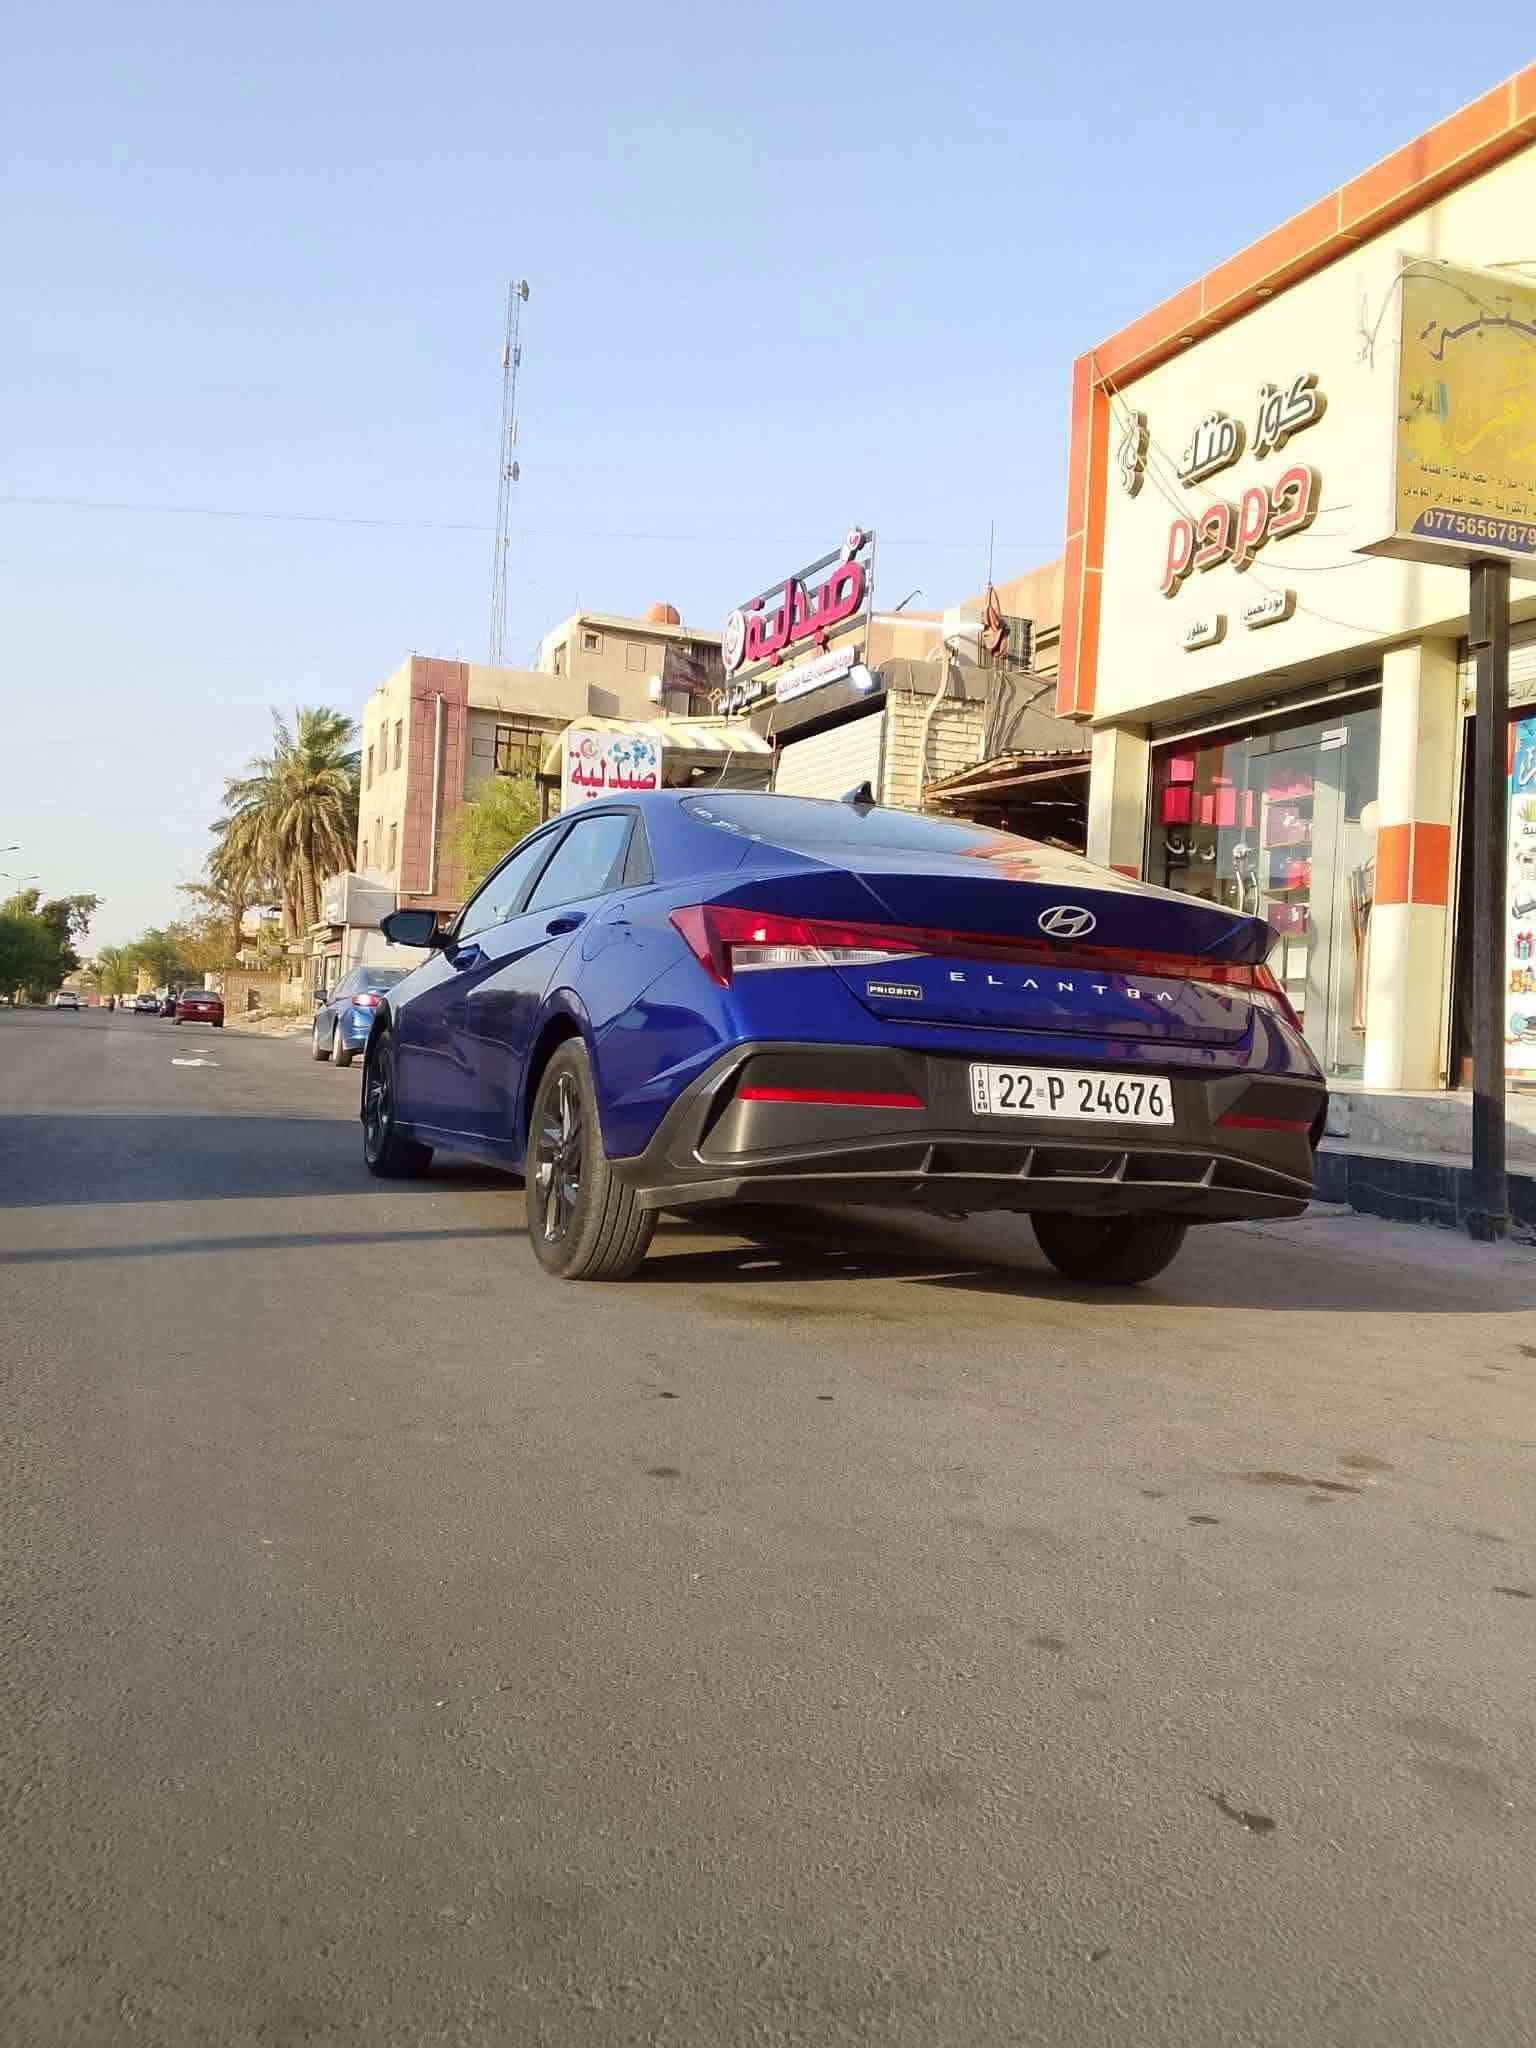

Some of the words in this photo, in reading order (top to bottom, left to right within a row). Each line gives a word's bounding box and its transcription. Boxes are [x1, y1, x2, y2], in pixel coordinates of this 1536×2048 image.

[745, 559, 867, 666] صيدلية
[569, 751, 657, 798] صيدلية
[868, 983, 921, 998] PRIORITY
[949, 970, 1174, 1002] ELANTRA
[998, 1074, 1035, 1110] 22
[1047, 1076, 1065, 1111] P
[1077, 1078, 1164, 1118] 24676
